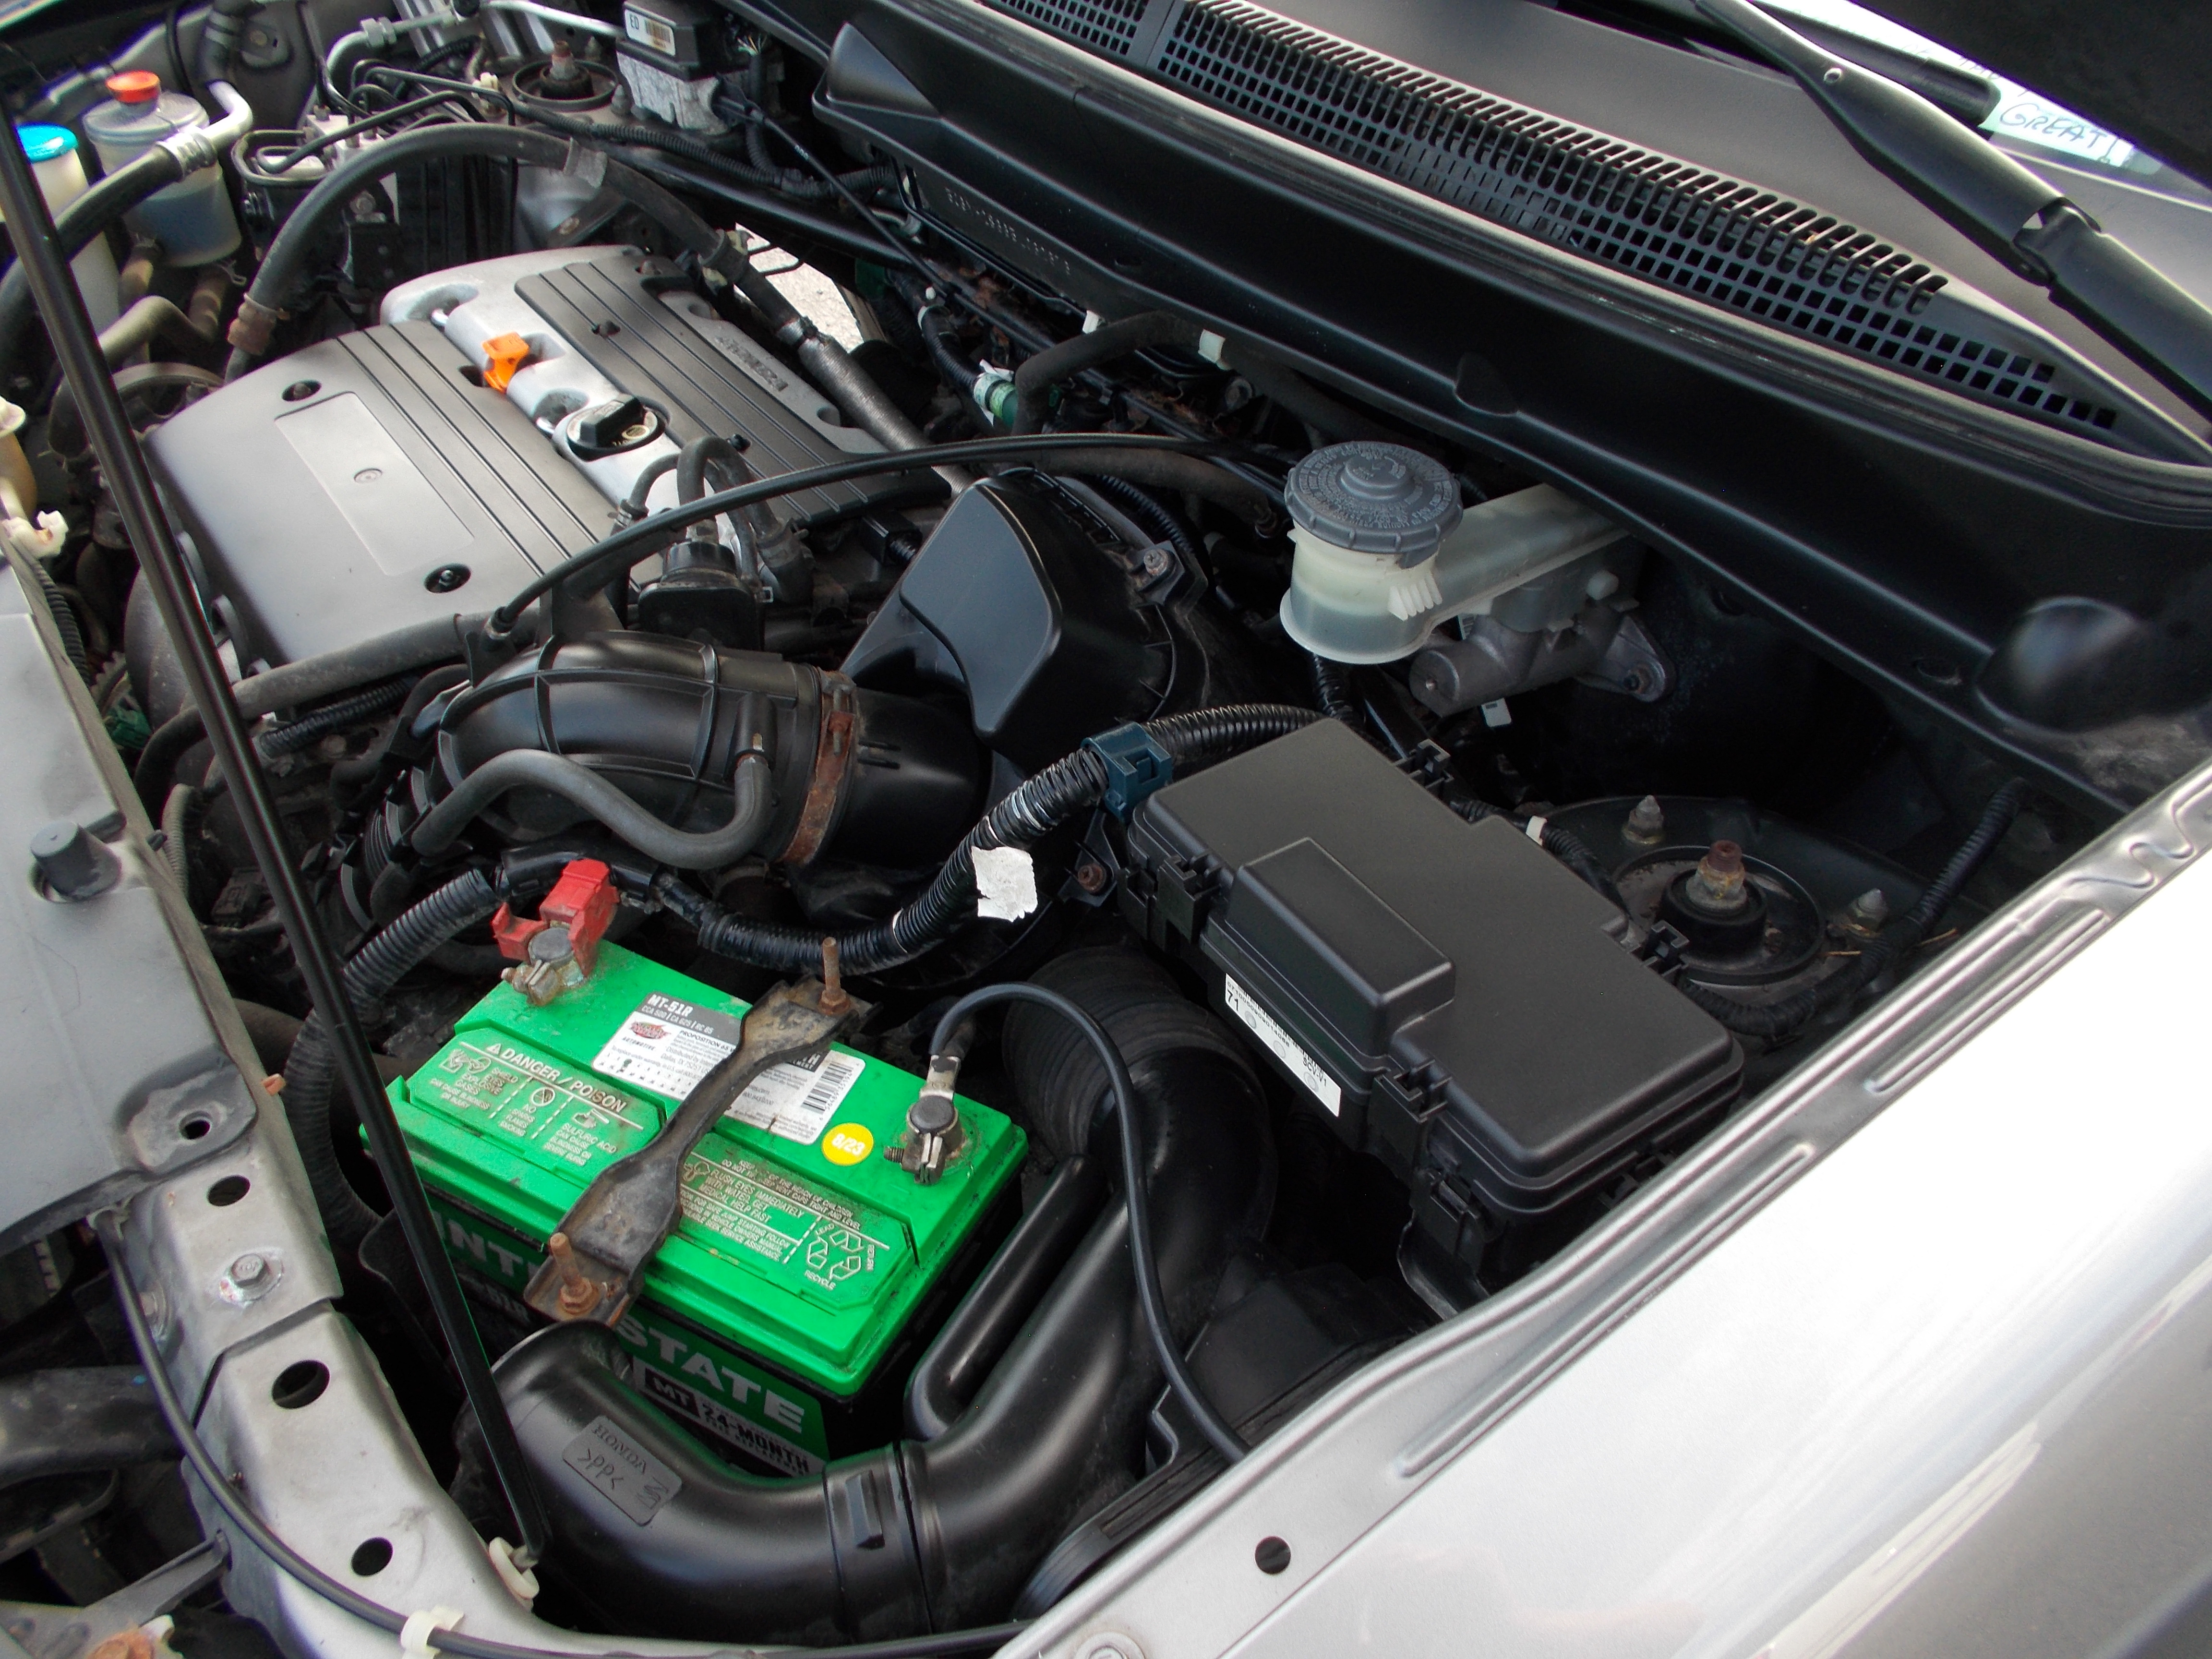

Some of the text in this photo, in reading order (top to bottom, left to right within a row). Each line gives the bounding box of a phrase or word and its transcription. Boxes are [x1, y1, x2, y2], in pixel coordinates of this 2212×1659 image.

[640, 1005, 656, 1013] CCA
[646, 994, 695, 1016] MT-51R
[1227, 990, 1239, 1011] 71
[622, 1036, 656, 1050] AUTOMOTIVE
[678, 1030, 722, 1047] PROPOSITION
[453, 1079, 482, 1095] GASES
[500, 1047, 562, 1082] DANGER
[568, 1080, 627, 1113] POISON
[521, 1103, 538, 1114] NO
[560, 1122, 618, 1154] SULFURIC ACID
[832, 1133, 866, 1157] 8/23
[721, 1159, 733, 1167] DO
[731, 1164, 746, 1173] NOT
[696, 1183, 732, 1203] MEDICAL
[729, 1199, 753, 1213] HELP
[703, 1176, 727, 1190] WITH
[751, 1199, 770, 1211] GET
[709, 1169, 738, 1185] FLUSH
[733, 1180, 757, 1194] EYES
[753, 1190, 805, 1218] IMMEDIATELY
[735, 1218, 769, 1237] STARTING
[816, 1224, 835, 1236] LEAD
[805, 1270, 837, 1291] RECYCLE
[652, 1377, 810, 1475] MT 24-MONTH
[591, 1424, 647, 1475] HONDA
